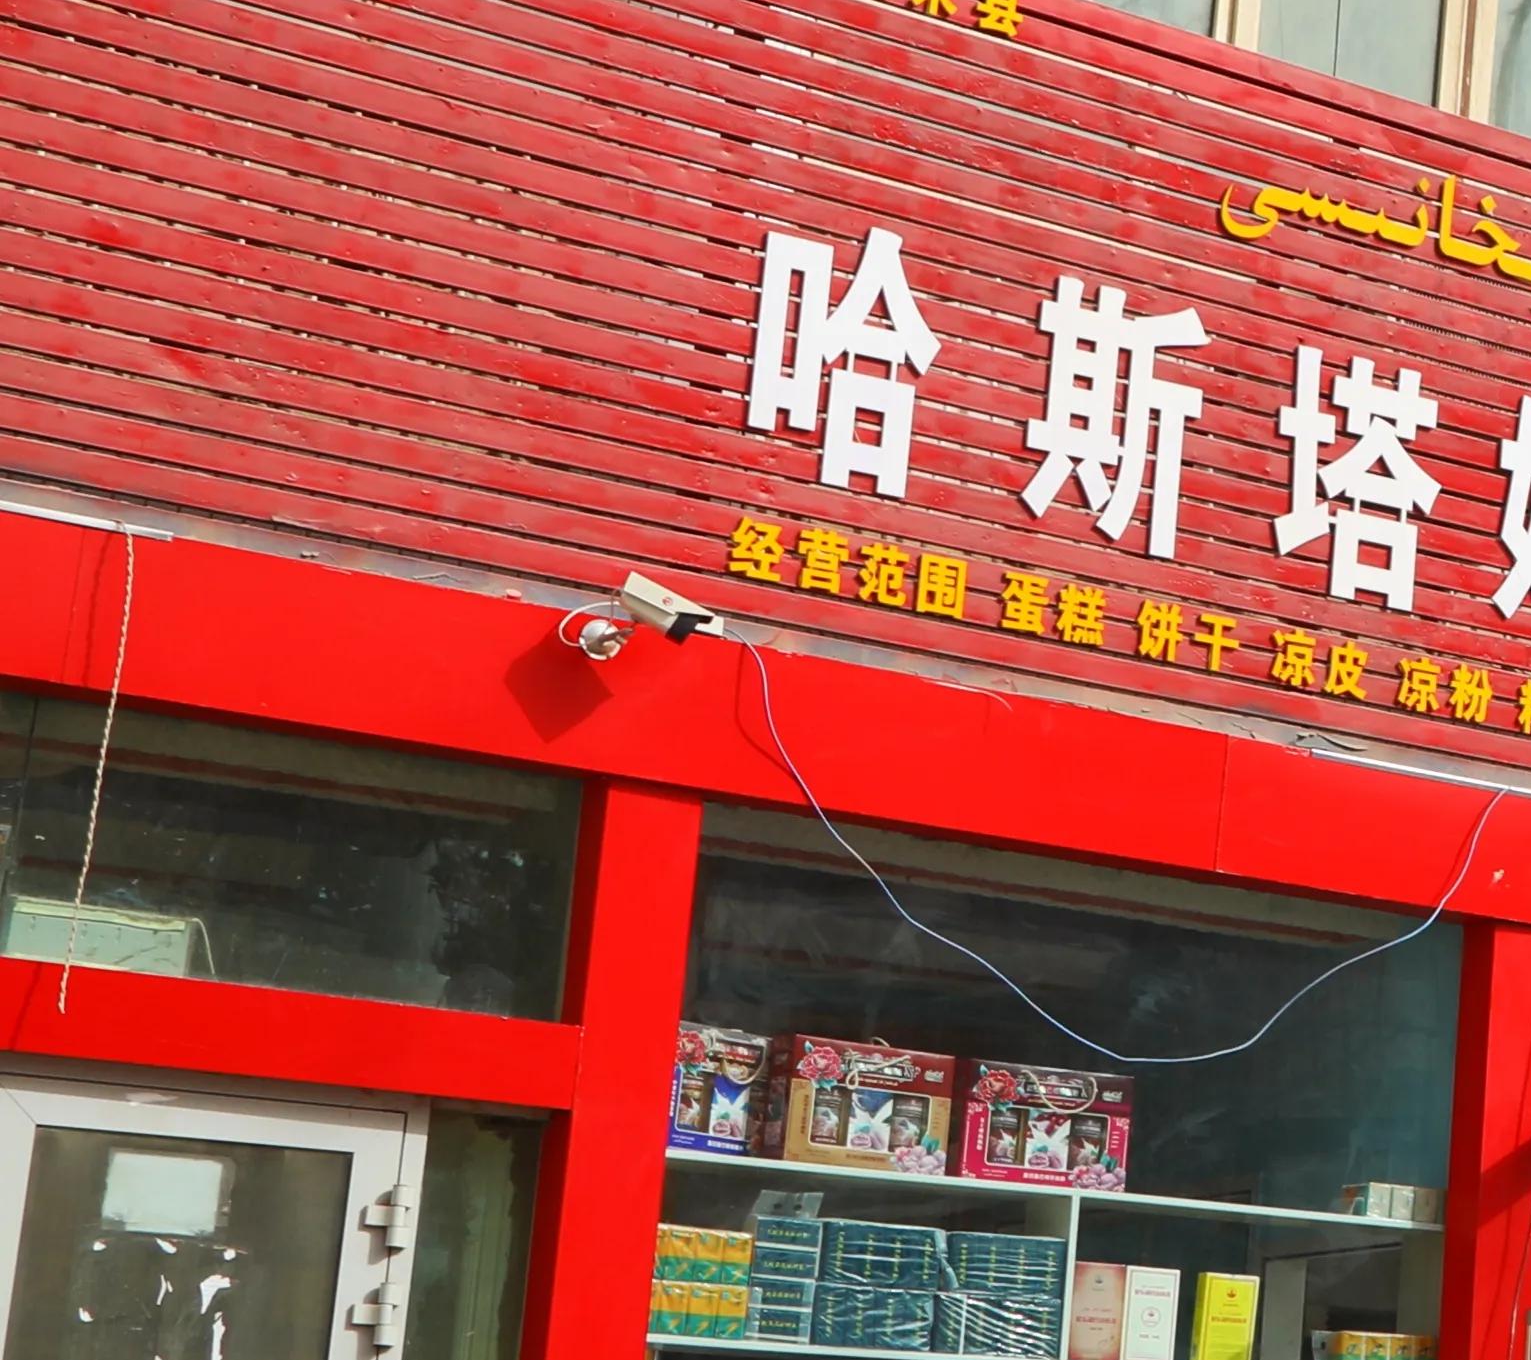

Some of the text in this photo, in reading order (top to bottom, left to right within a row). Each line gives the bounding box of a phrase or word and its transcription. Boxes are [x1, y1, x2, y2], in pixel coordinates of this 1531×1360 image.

[728, 516, 969, 621] 经营范围
[999, 571, 1108, 648] 蛋糕
[1137, 597, 1241, 672] 饼干
